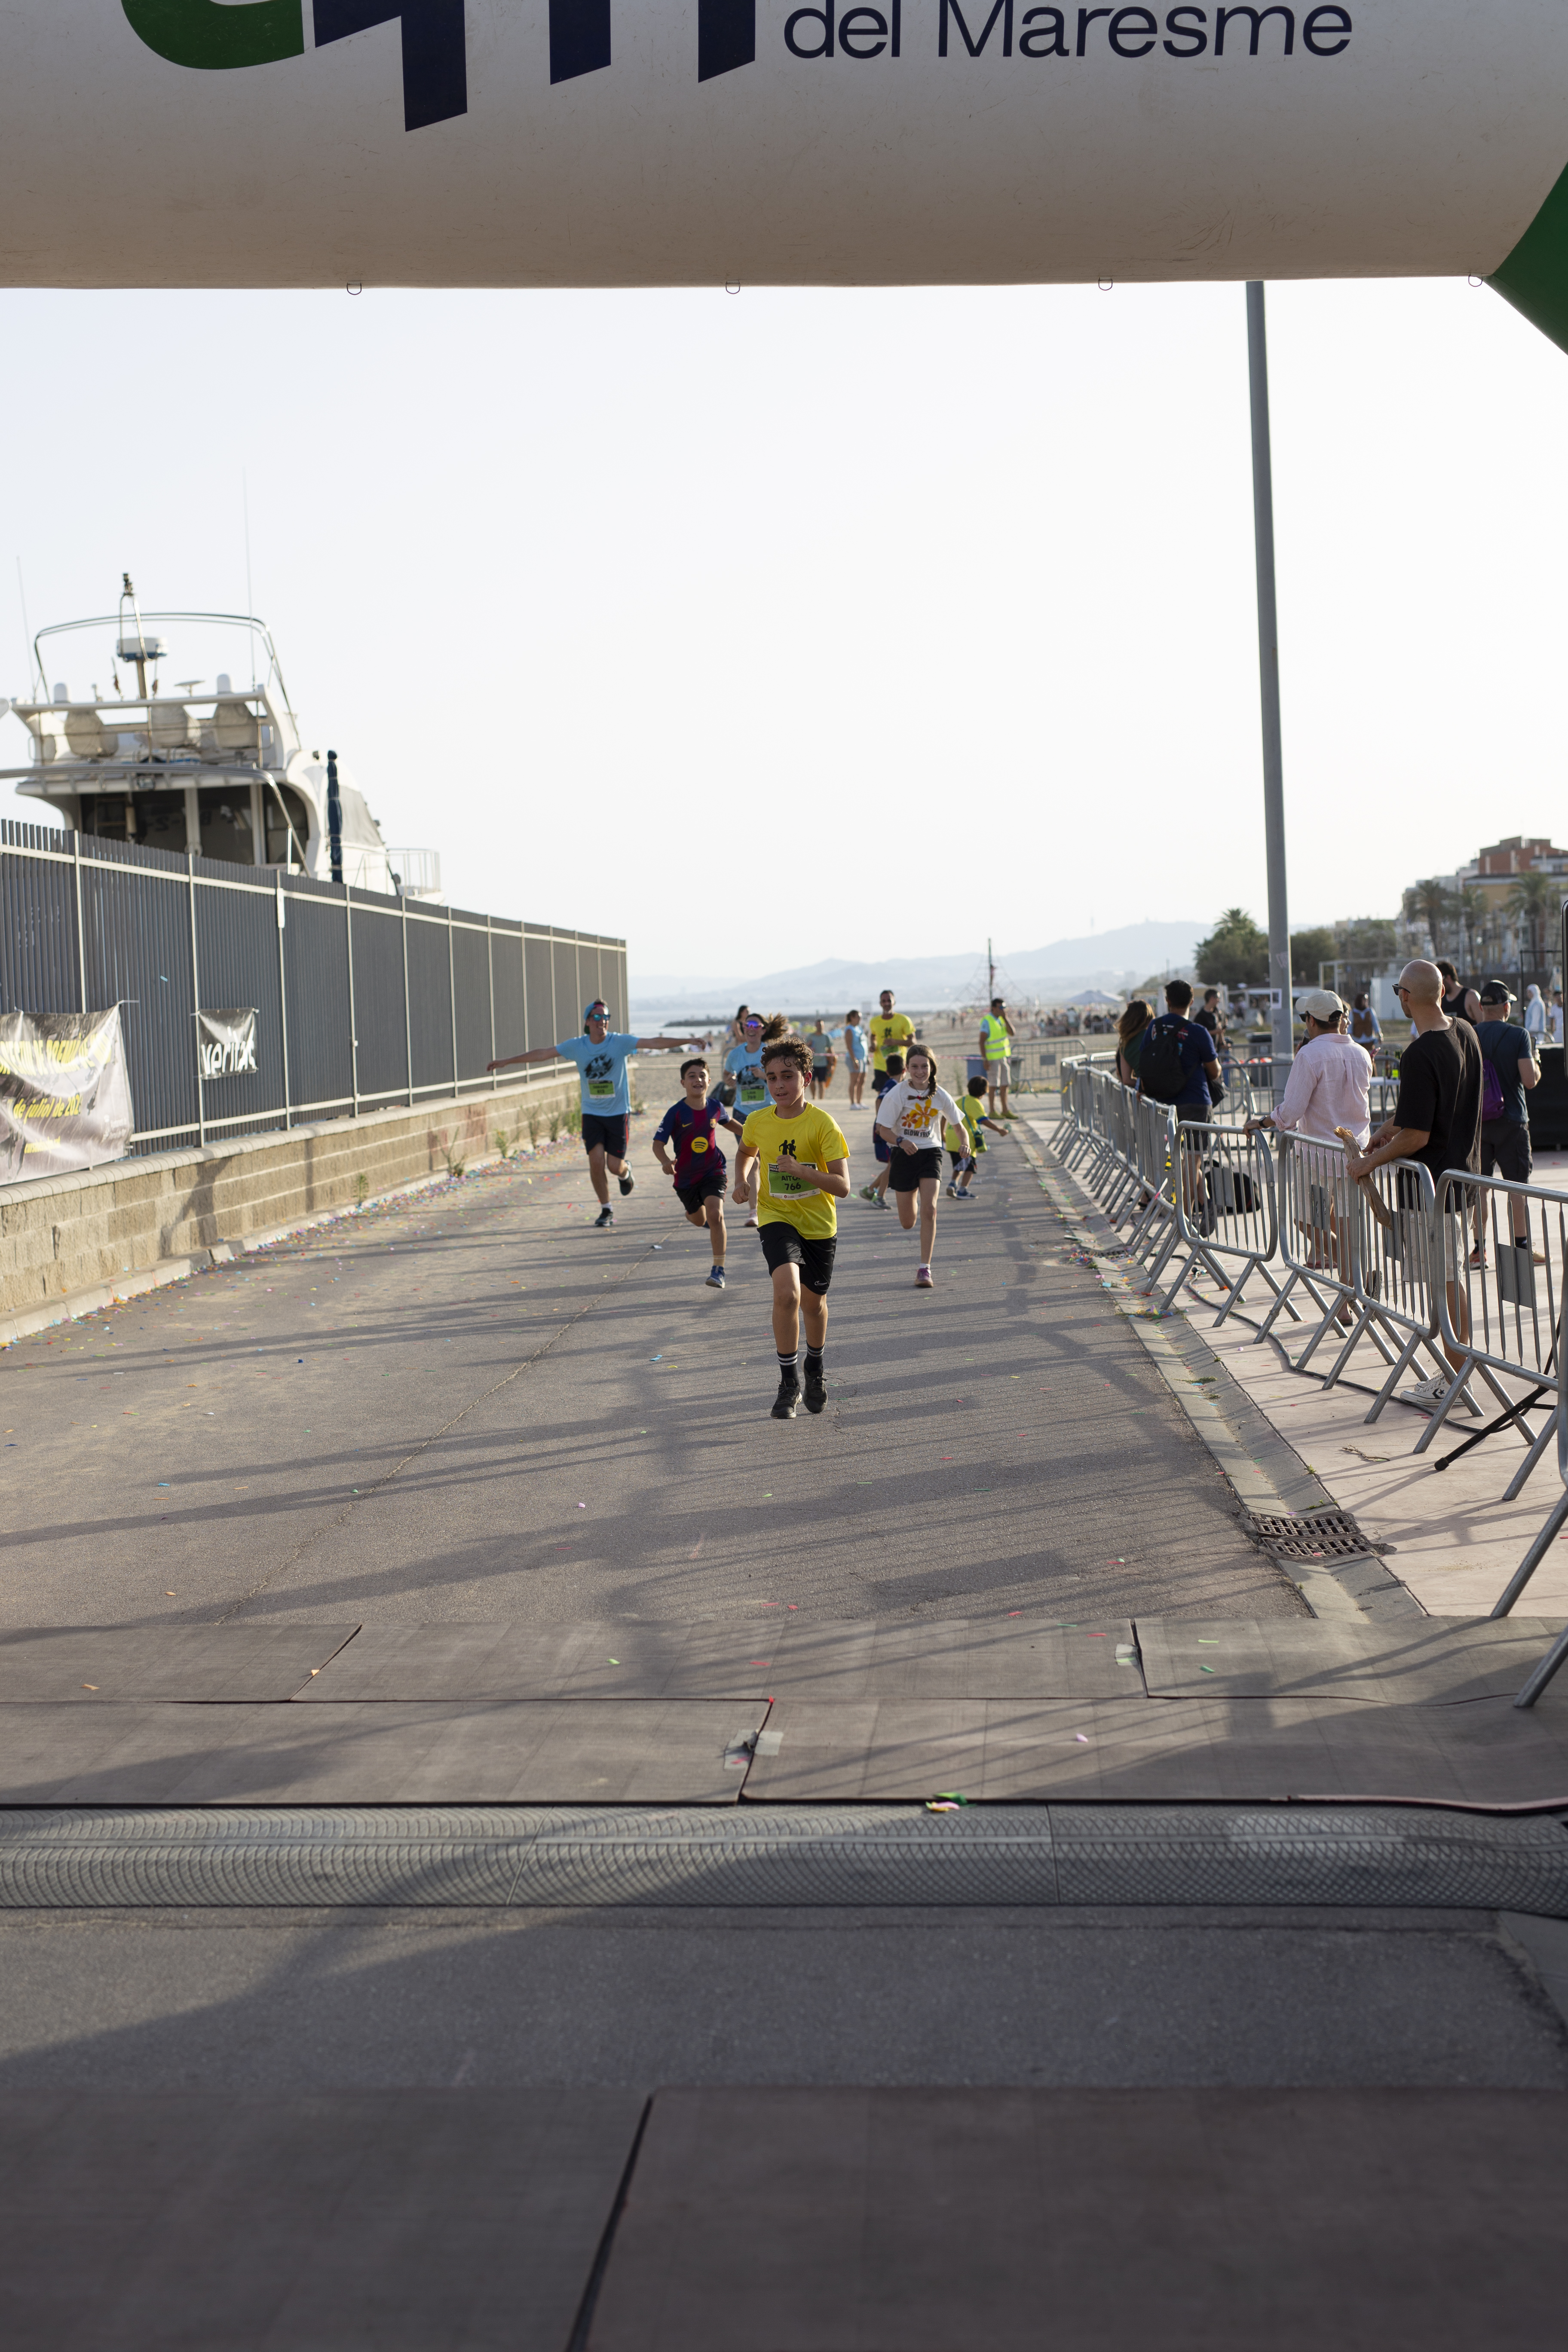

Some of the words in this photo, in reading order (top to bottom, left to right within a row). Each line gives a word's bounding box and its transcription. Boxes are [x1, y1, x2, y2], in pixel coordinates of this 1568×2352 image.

[784, 0, 901, 59] del
[937, 0, 1353, 58] Maresme
[13, 1098, 26, 1119] de
[24, 1097, 55, 1124] juliol
[52, 1096, 64, 1118] de
[784, 1182, 802, 1191] 766
